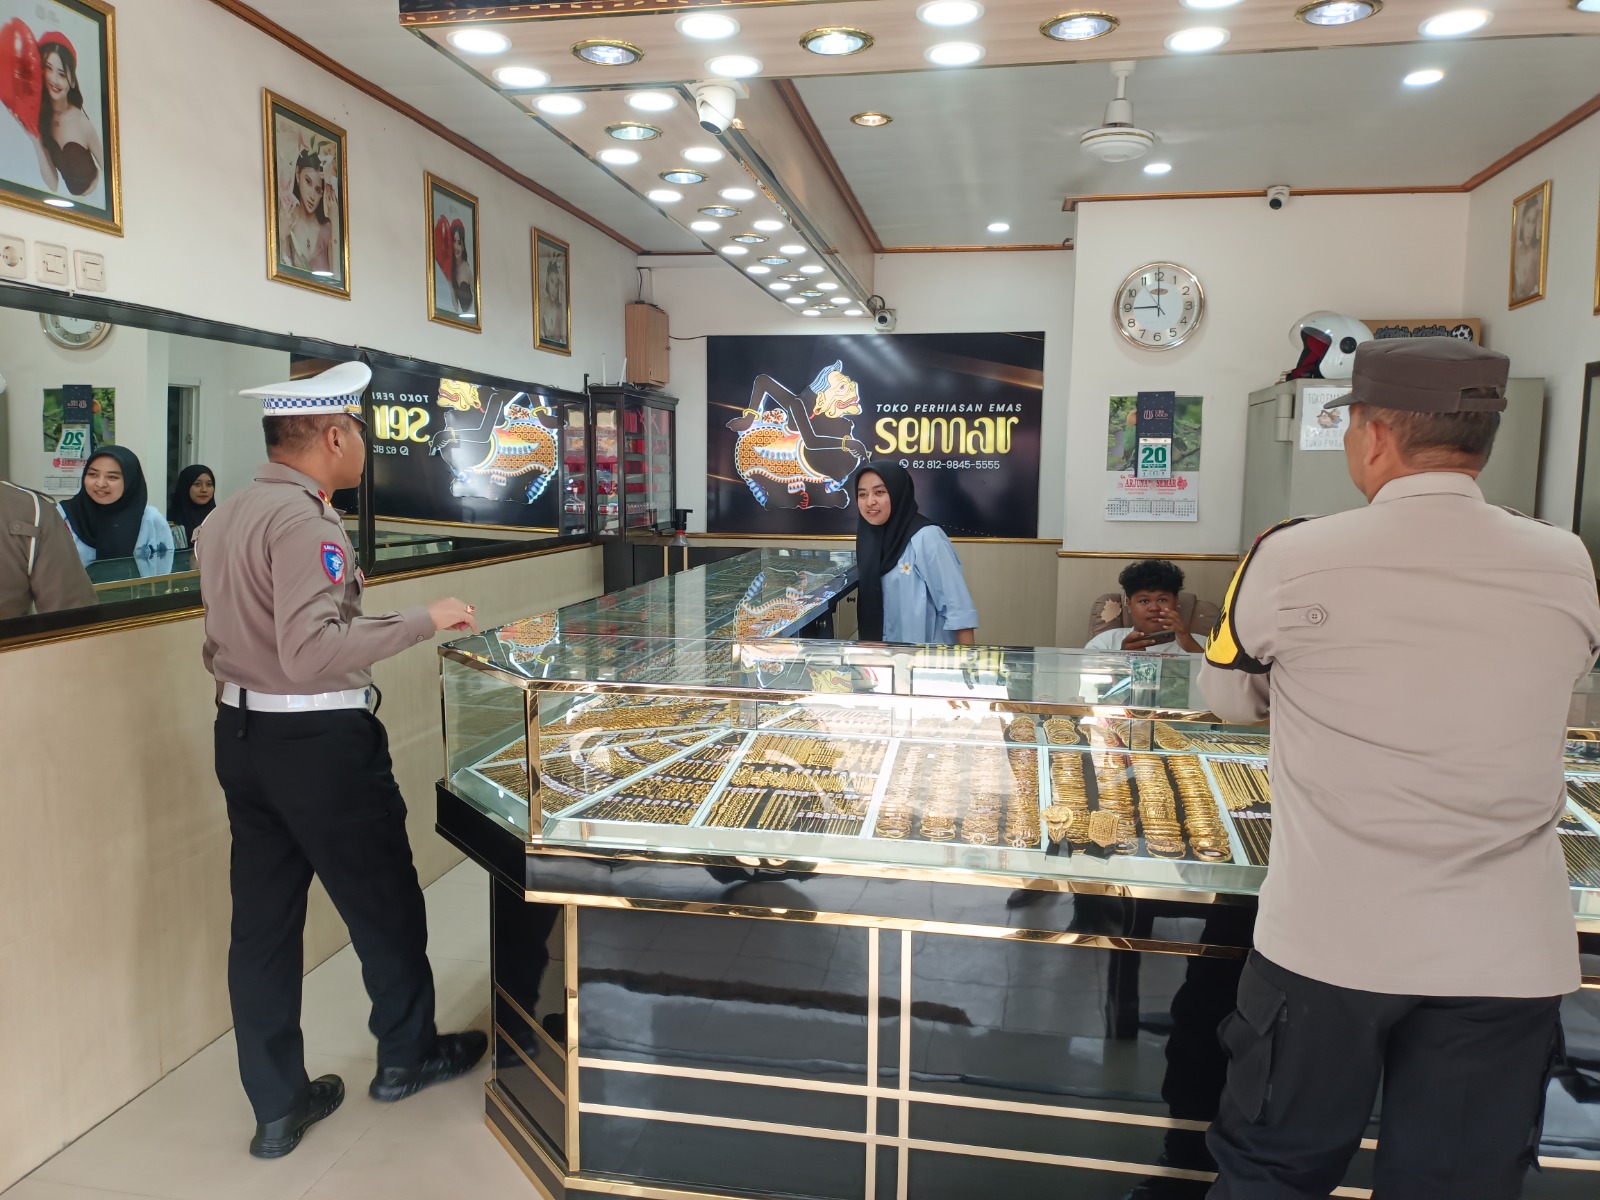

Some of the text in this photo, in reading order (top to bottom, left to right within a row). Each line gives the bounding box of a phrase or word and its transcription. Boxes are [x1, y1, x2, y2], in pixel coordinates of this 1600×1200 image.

[1141, 276, 1147, 286] 11
[1154, 271, 1165, 282] 12
[1173, 275, 1177, 285] 1
[1128, 288, 1137, 298] 10
[1182, 286, 1190, 296] 2
[1123, 303, 1132, 313] 9
[1185, 301, 1193, 311] 3
[1127, 318, 1136, 328] 8
[1180, 316, 1188, 325] 4
[1138, 329, 1146, 339] 7
[1153, 332, 1162, 342] 6
[1169, 327, 1177, 337] 5
[876, 403, 1022, 413] TOKO PERHIASAN EMAS
[1141, 446, 1167, 464] 20
[912, 460, 1000, 470] 62 812-9845-5555
